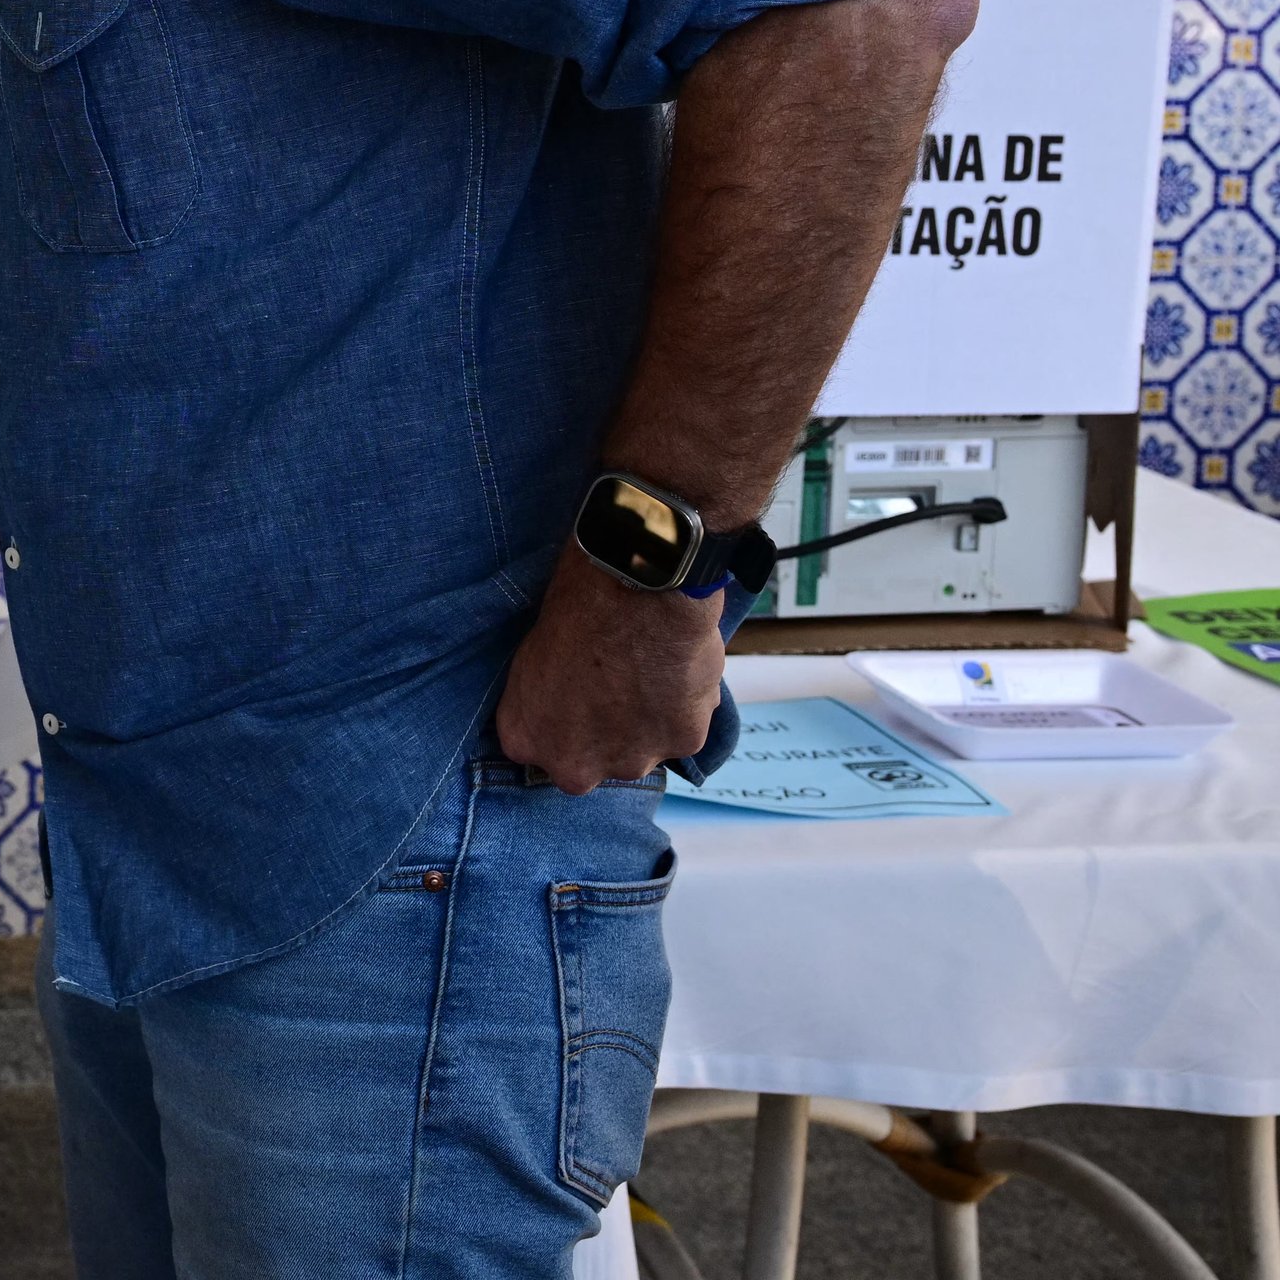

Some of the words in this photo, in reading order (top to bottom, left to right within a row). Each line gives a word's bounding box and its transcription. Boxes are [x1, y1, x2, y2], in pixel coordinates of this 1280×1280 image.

[921, 134, 985, 182] NA
[1003, 134, 1064, 182] DE
[891, 195, 1043, 270] TAÇÃO
[744, 745, 894, 761] DURANTE
